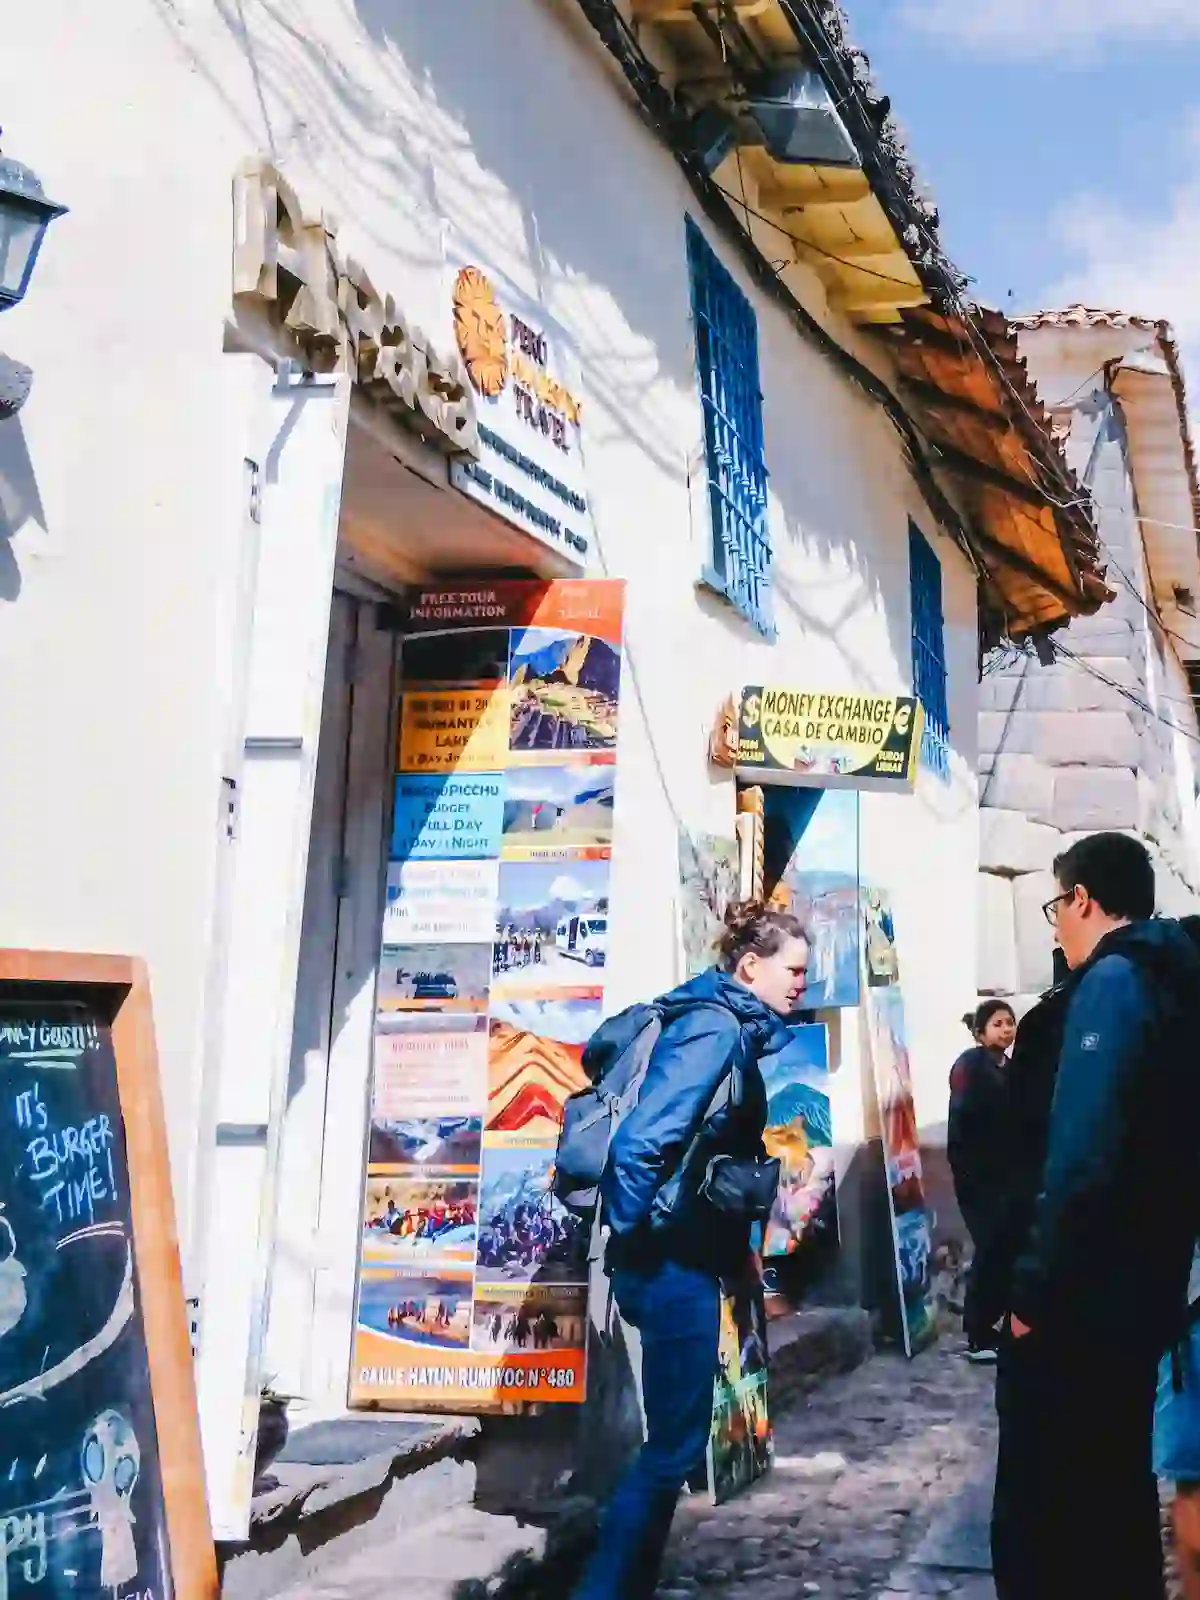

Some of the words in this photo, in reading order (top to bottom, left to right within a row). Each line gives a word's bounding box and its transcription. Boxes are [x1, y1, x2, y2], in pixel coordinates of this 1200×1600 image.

[420, 591, 457, 605] FREE
[460, 589, 496, 603] TOUR
[409, 605, 506, 619] INFORMATION
[764, 691, 815, 717] MONEY
[817, 695, 891, 723] EXCHANGE
[763, 718, 800, 738] CASA
[805, 721, 821, 739] DE
[827, 723, 884, 744] CAMBIO
[424, 803, 470, 814] BUDGET
[454, 819, 483, 832] DAY
[451, 835, 489, 849] NIGHT
[26, 1114, 114, 1181] BURGER
[360, 1367, 406, 1387] CALLE
[409, 1367, 455, 1389] HATUN
[457, 1367, 525, 1390] RUMIYOC
